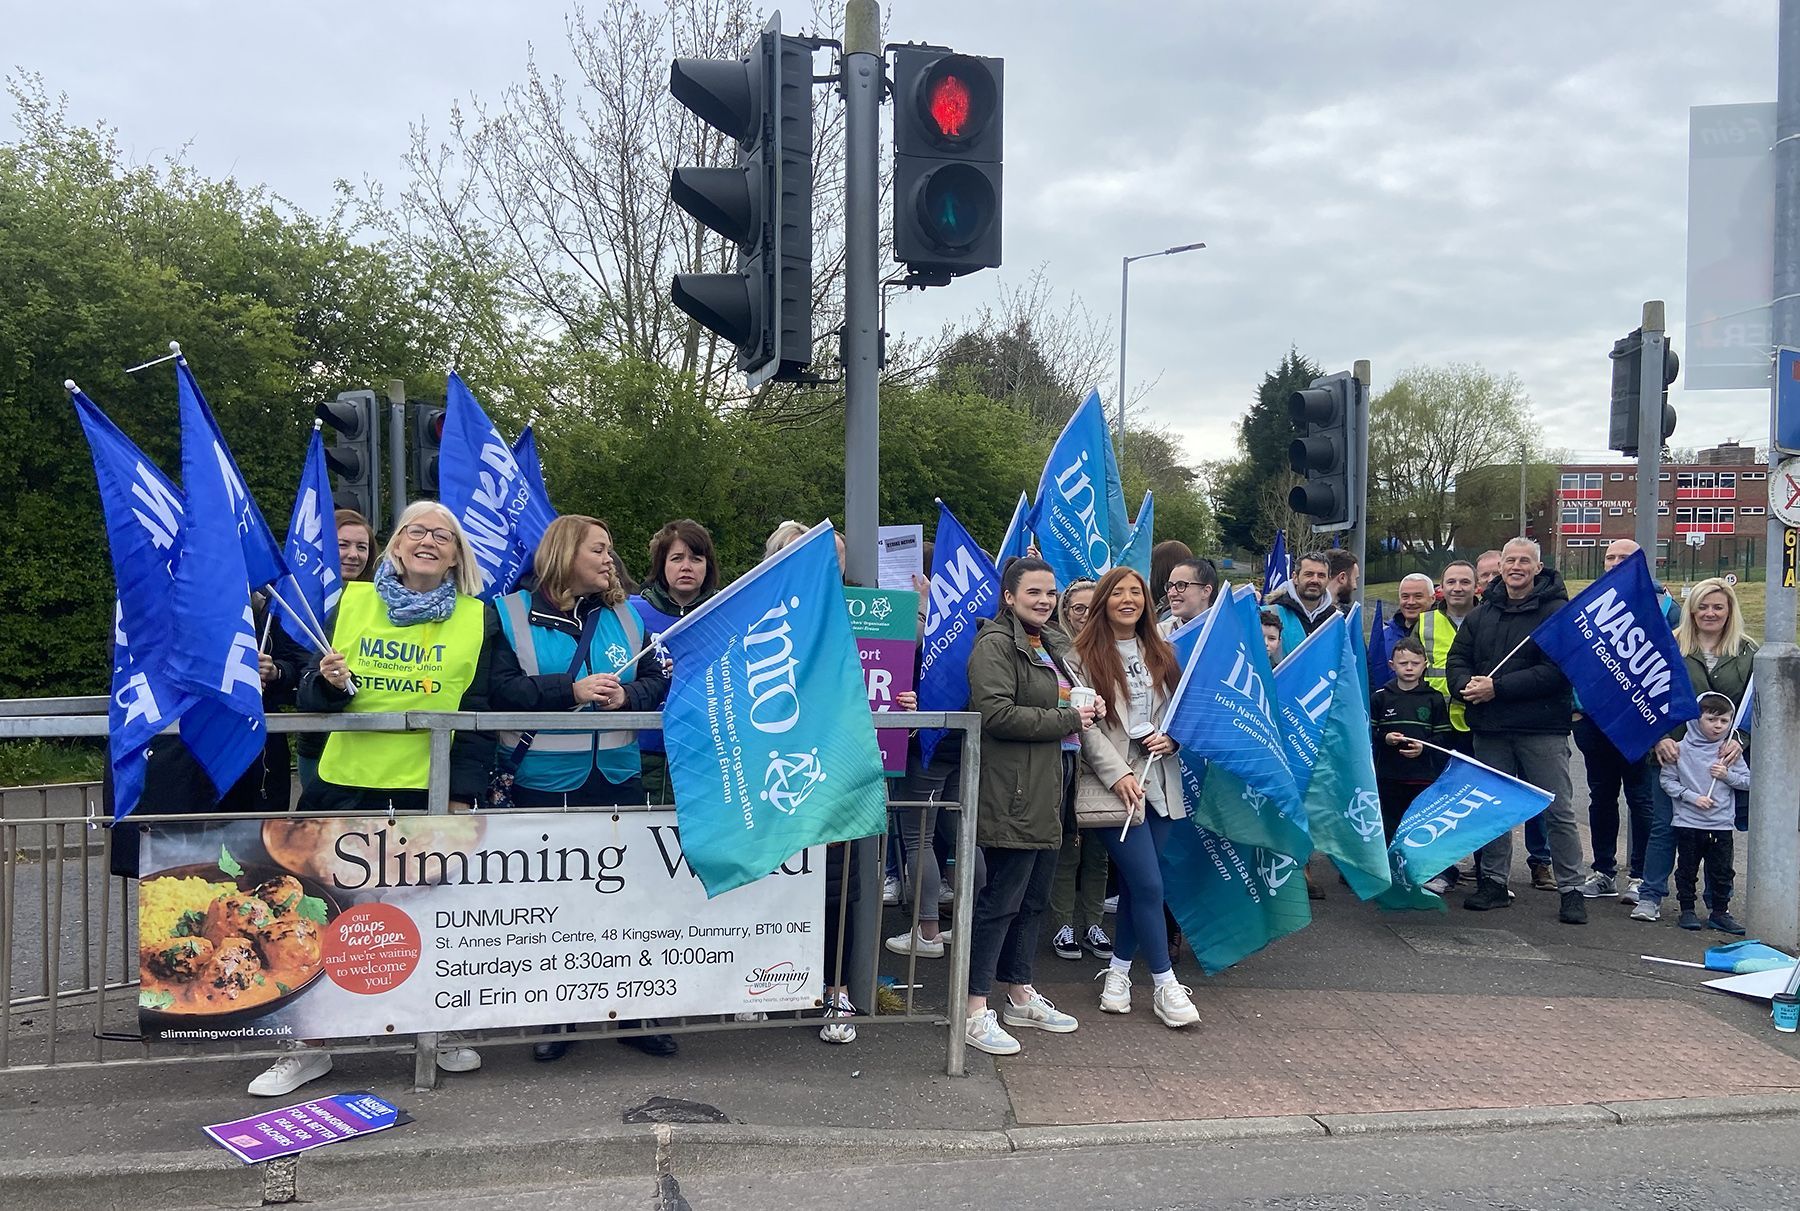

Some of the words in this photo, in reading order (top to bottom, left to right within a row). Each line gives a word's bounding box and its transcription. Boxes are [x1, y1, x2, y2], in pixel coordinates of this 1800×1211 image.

[1597, 500, 1633, 508] PRIMARY
[357, 658, 371, 667] The
[359, 637, 447, 664] NASUWT
[1573, 611, 1593, 640] The
[1591, 637, 1637, 691] Teachers'
[1631, 689, 1658, 725] Union
[1214, 692, 1236, 713] Irish
[1282, 706, 1299, 728] Irish
[1232, 717, 1272, 746] Cumann
[1288, 733, 1315, 768] Cumann
[718, 756, 733, 805] Éireann
[731, 744, 755, 830] Organisation
[332, 828, 628, 894] Slimming
[1219, 836, 1261, 904] rganisation
[351, 913, 371, 922] our
[435, 906, 560, 929] DUNMURRY
[340, 920, 386, 942] groups
[348, 935, 372, 946] are
[374, 932, 406, 948] open
[435, 936, 453, 949] St.
[458, 935, 501, 948] Annes
[506, 932, 547, 946] Parish
[551, 930, 598, 943] Centre,
[601, 929, 618, 941] 48
[622, 928, 684, 943] Kingsway,
[688, 925, 751, 940] Dunmurry,
[755, 922, 782, 935] BT10
[325, 951, 347, 964] and
[349, 950, 376, 962] we're
[379, 947, 418, 959] waiting
[435, 957, 532, 978] Saturdays
[539, 954, 557, 971] at
[563, 951, 631, 970] 8:30am
[638, 949, 653, 967] &
[660, 947, 735, 966] 10:00am
[336, 968, 348, 977] to
[349, 960, 407, 976] welcome
[364, 972, 393, 990] you!
[745, 967, 810, 994] Slimming
[435, 989, 471, 1009] Call
[479, 987, 517, 1006] Erin
[524, 988, 548, 1003] on
[555, 982, 609, 1002] 07375
[616, 978, 677, 999] 517933
[160, 1025, 293, 1040] slimmingworld.co.uk
[254, 1122, 295, 1147] TEACHERS
